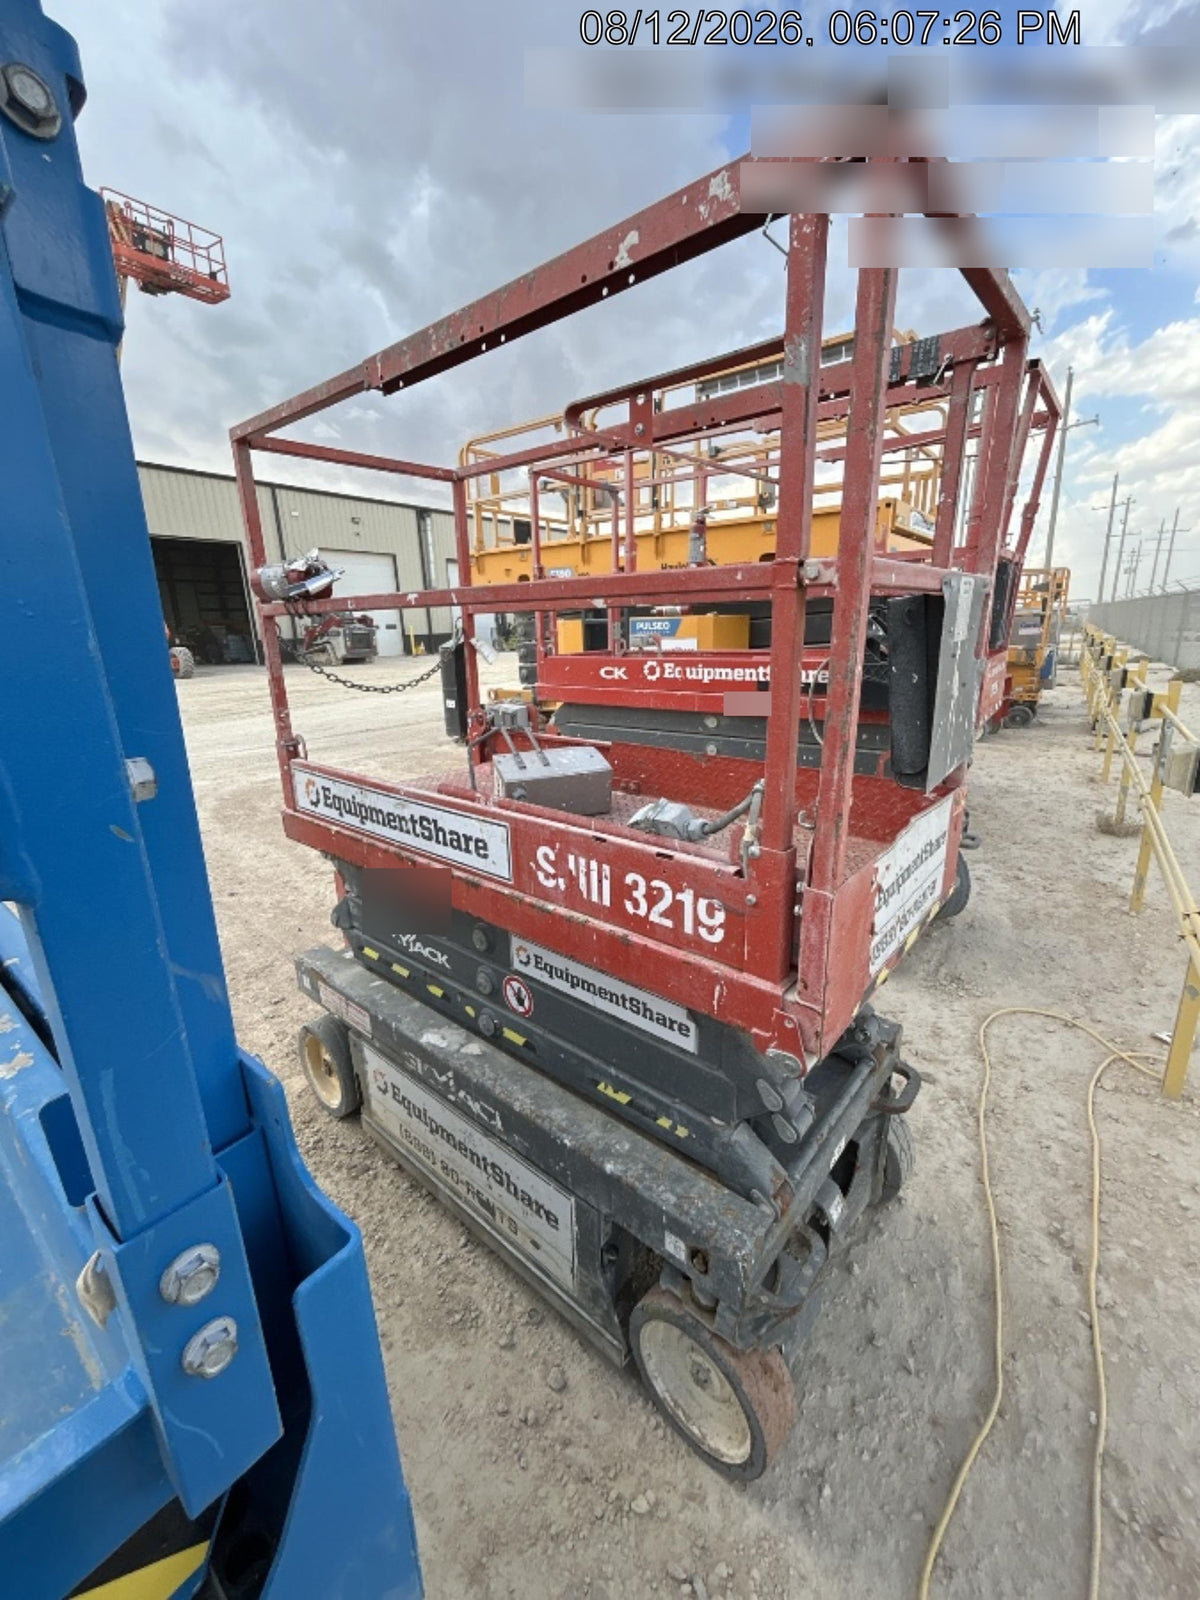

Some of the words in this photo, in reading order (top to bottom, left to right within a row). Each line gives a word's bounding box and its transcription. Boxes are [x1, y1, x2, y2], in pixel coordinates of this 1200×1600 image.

[321, 785, 489, 860] EquipmentShare
[624, 871, 726, 944] 3219
[533, 953, 692, 1038] EquipmentShare
[391, 1082, 560, 1231] EquipmentShare
